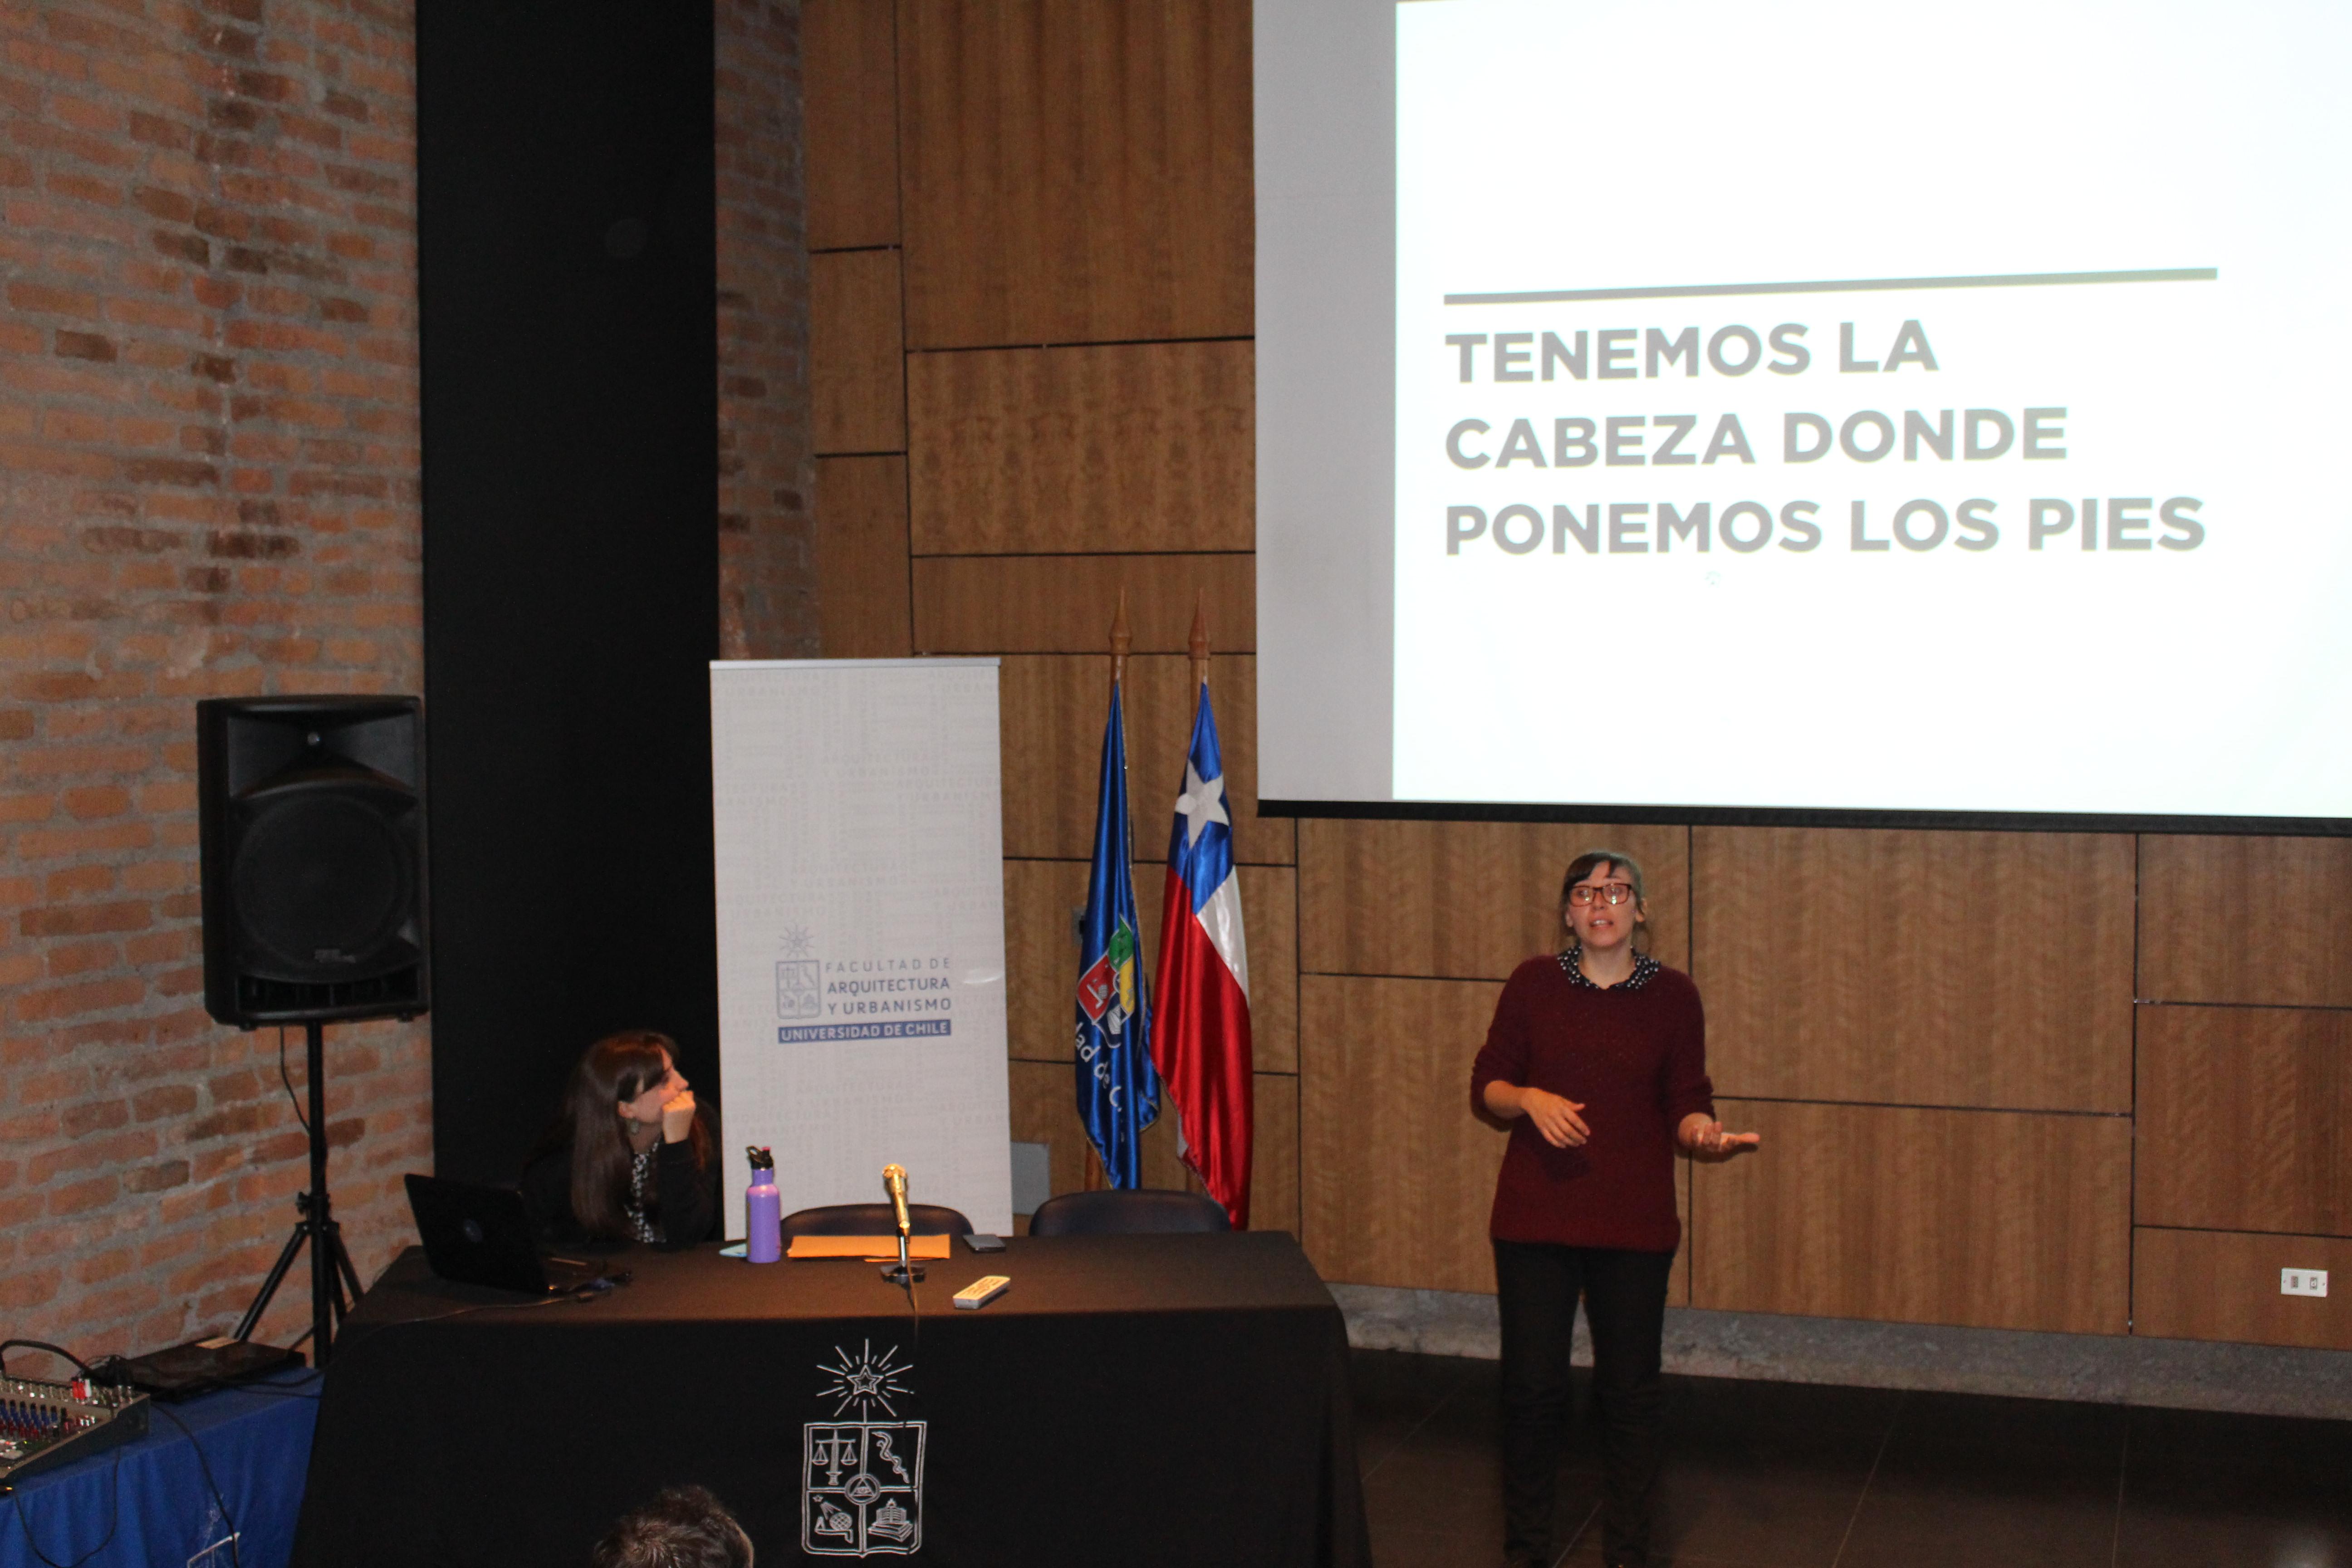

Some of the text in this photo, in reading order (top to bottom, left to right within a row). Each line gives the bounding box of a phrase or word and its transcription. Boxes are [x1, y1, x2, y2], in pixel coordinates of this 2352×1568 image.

[1445, 319, 1940, 383] TENEMOS LA
[1445, 407, 2067, 470] CABEZA DONDE
[1446, 496, 2205, 555] PONEMOS LOS PIES
[825, 958, 950, 973] FACULTAD DE
[827, 977, 950, 997] ARQUITECTURA
[828, 998, 951, 1015] Y URBANISMO
[781, 1022, 948, 1042] UNIVERSIDAD DE CHILE
